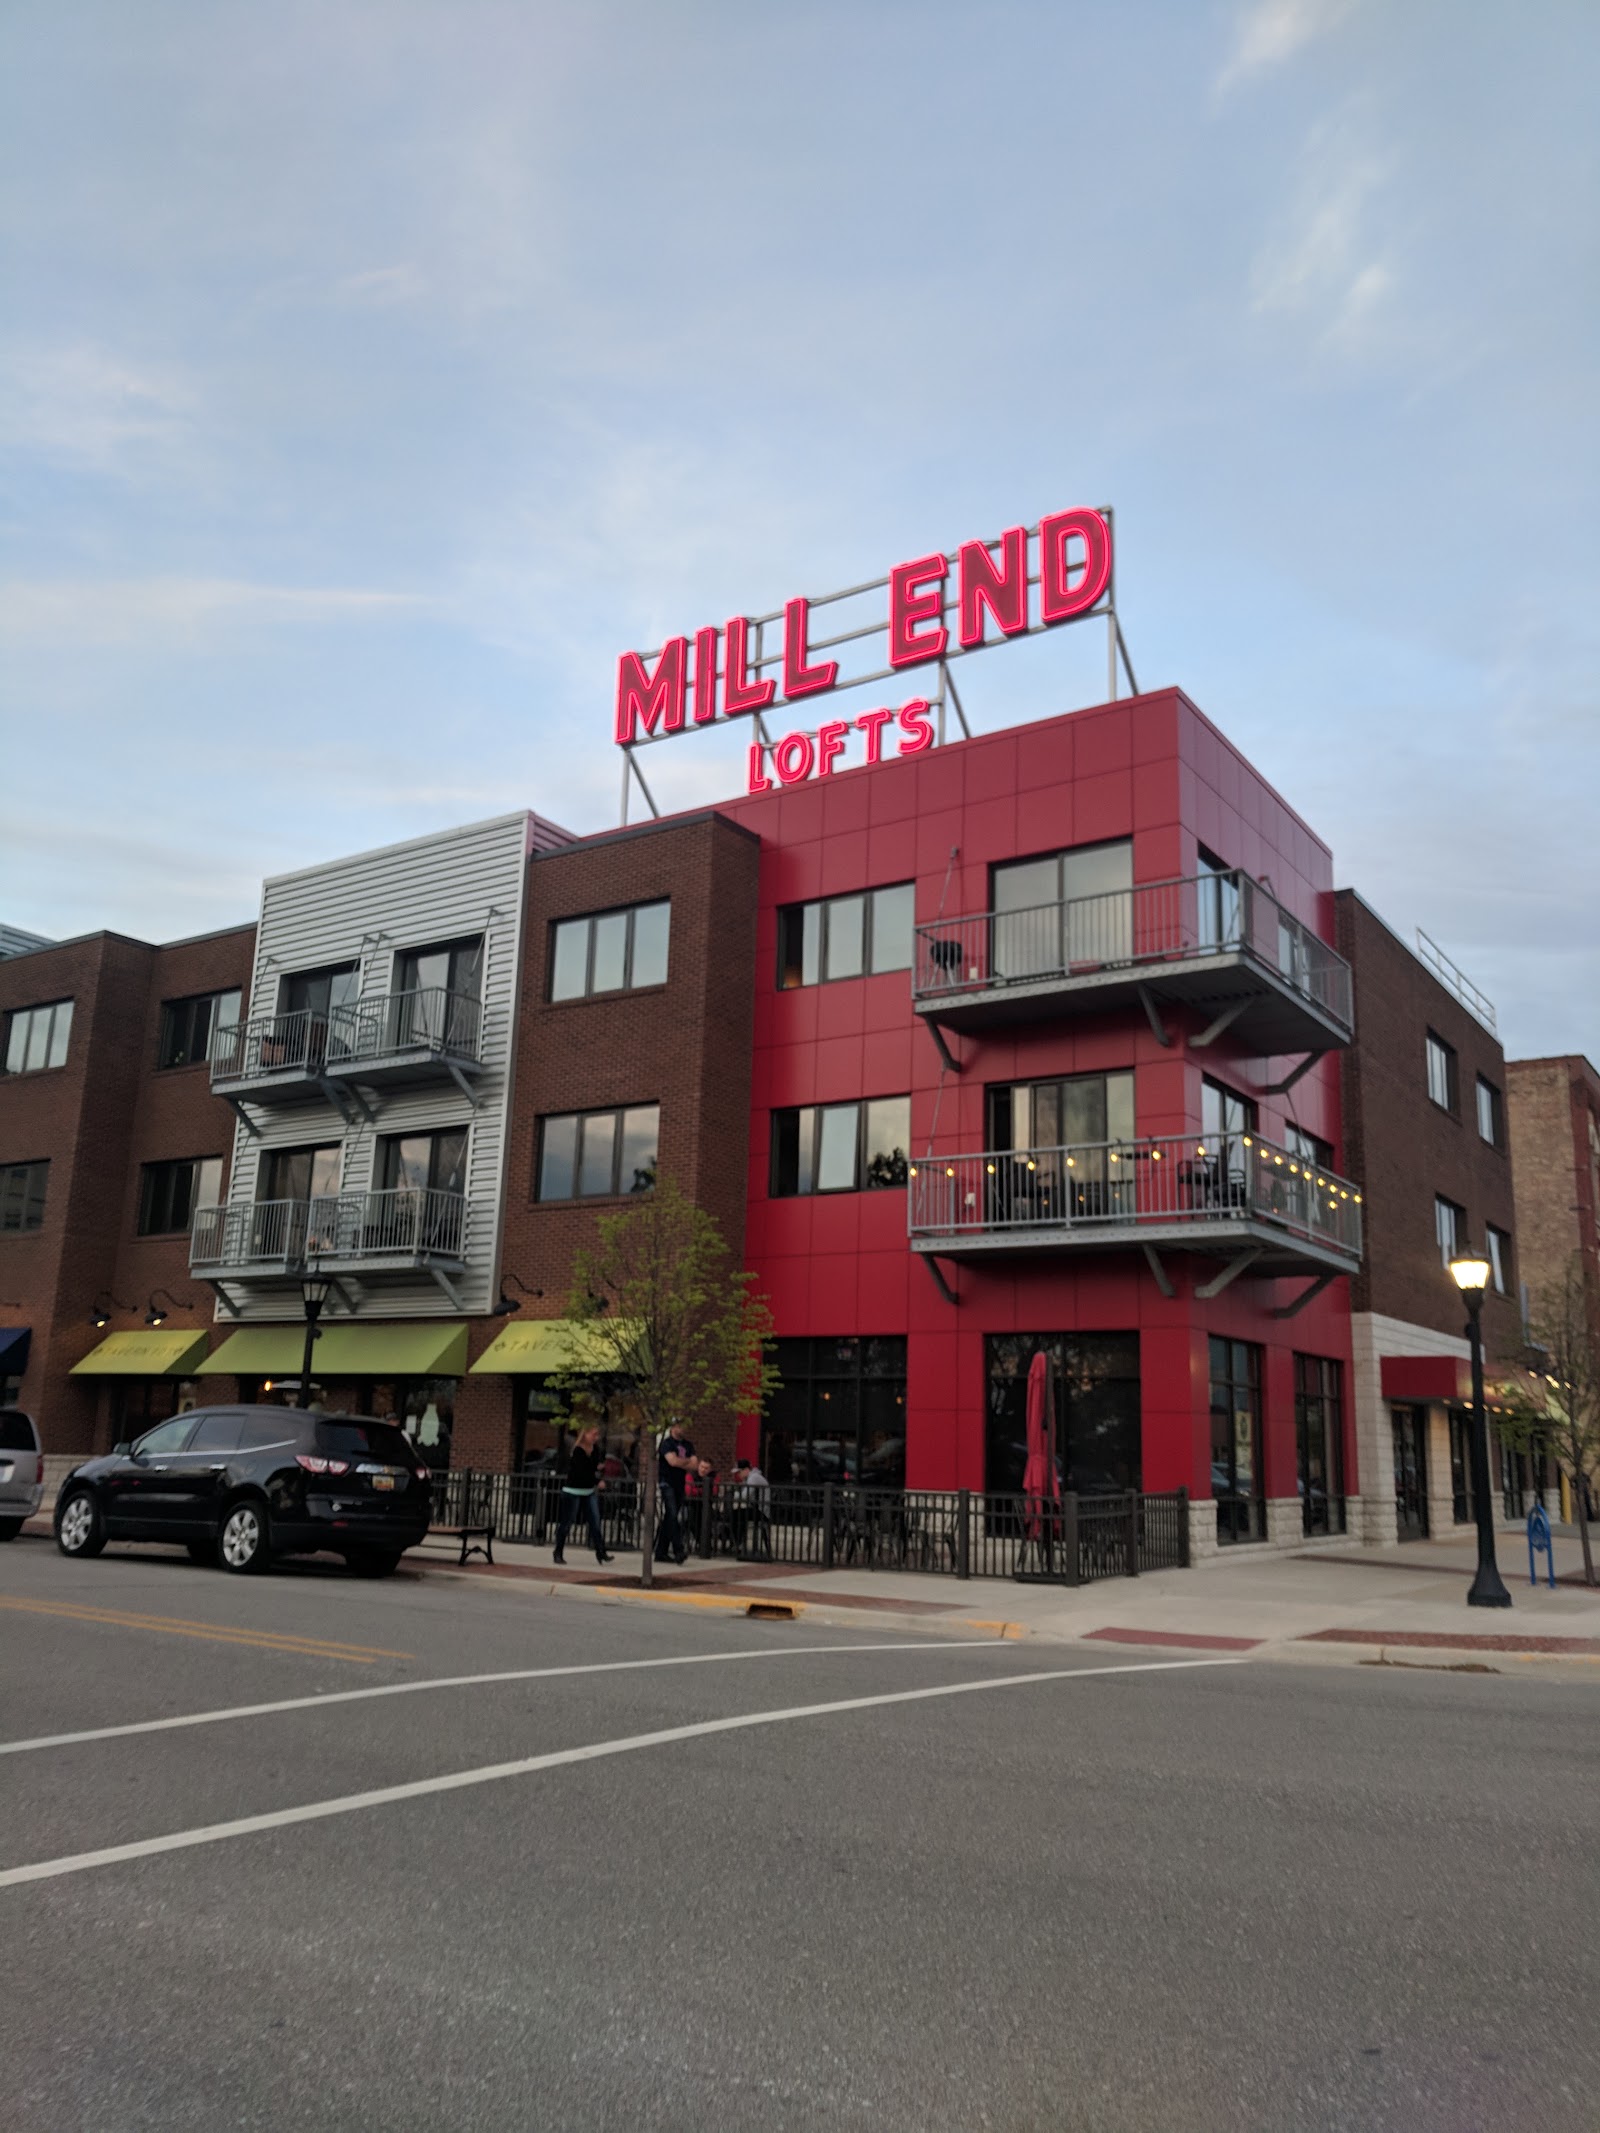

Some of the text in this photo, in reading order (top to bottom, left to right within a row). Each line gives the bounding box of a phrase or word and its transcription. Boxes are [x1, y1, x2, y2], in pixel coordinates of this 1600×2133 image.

[614, 507, 1112, 744] MILL END
[747, 697, 935, 794] LOFTS
